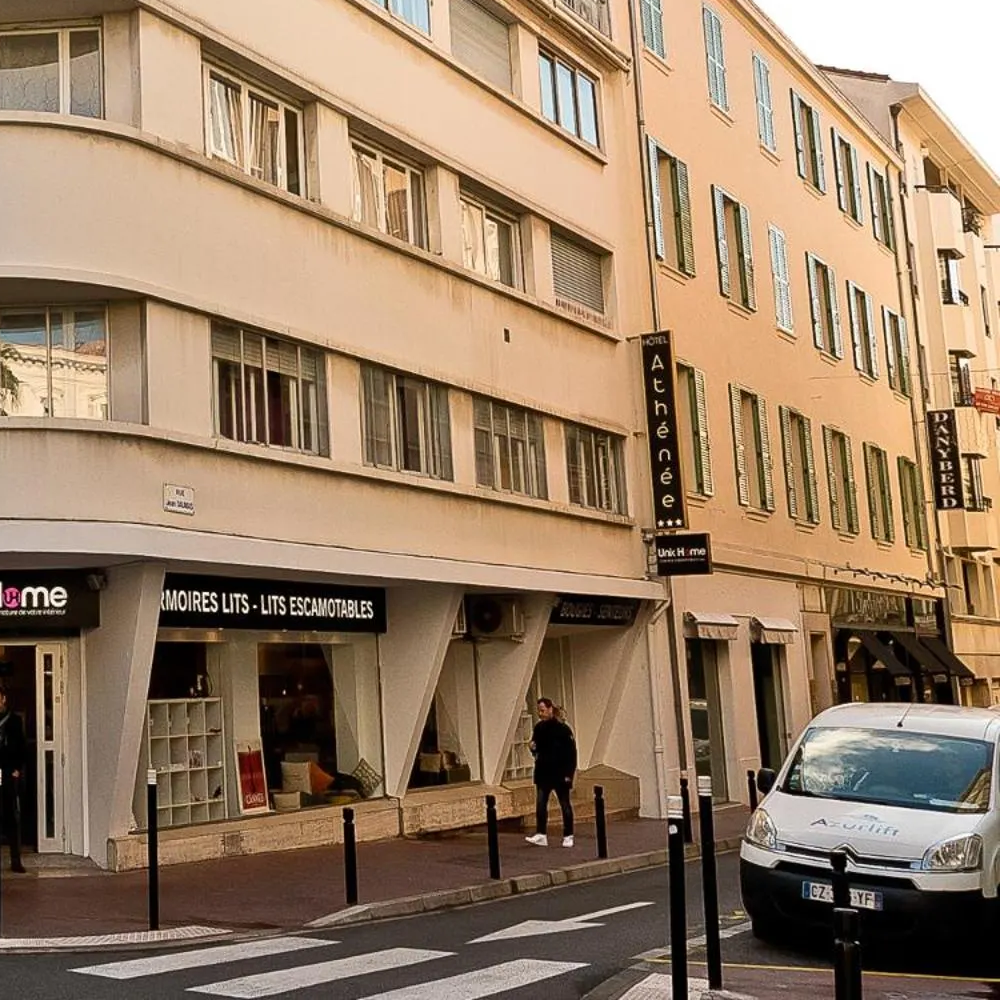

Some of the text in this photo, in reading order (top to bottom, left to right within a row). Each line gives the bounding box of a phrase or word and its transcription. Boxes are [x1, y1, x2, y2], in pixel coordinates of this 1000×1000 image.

[642, 335, 669, 347] HÔTEL
[651, 353, 675, 508] Athénée
[221, 592, 250, 615] LITS
[260, 594, 287, 616] LITS
[289, 596, 374, 620] ESCAMOTABLES
